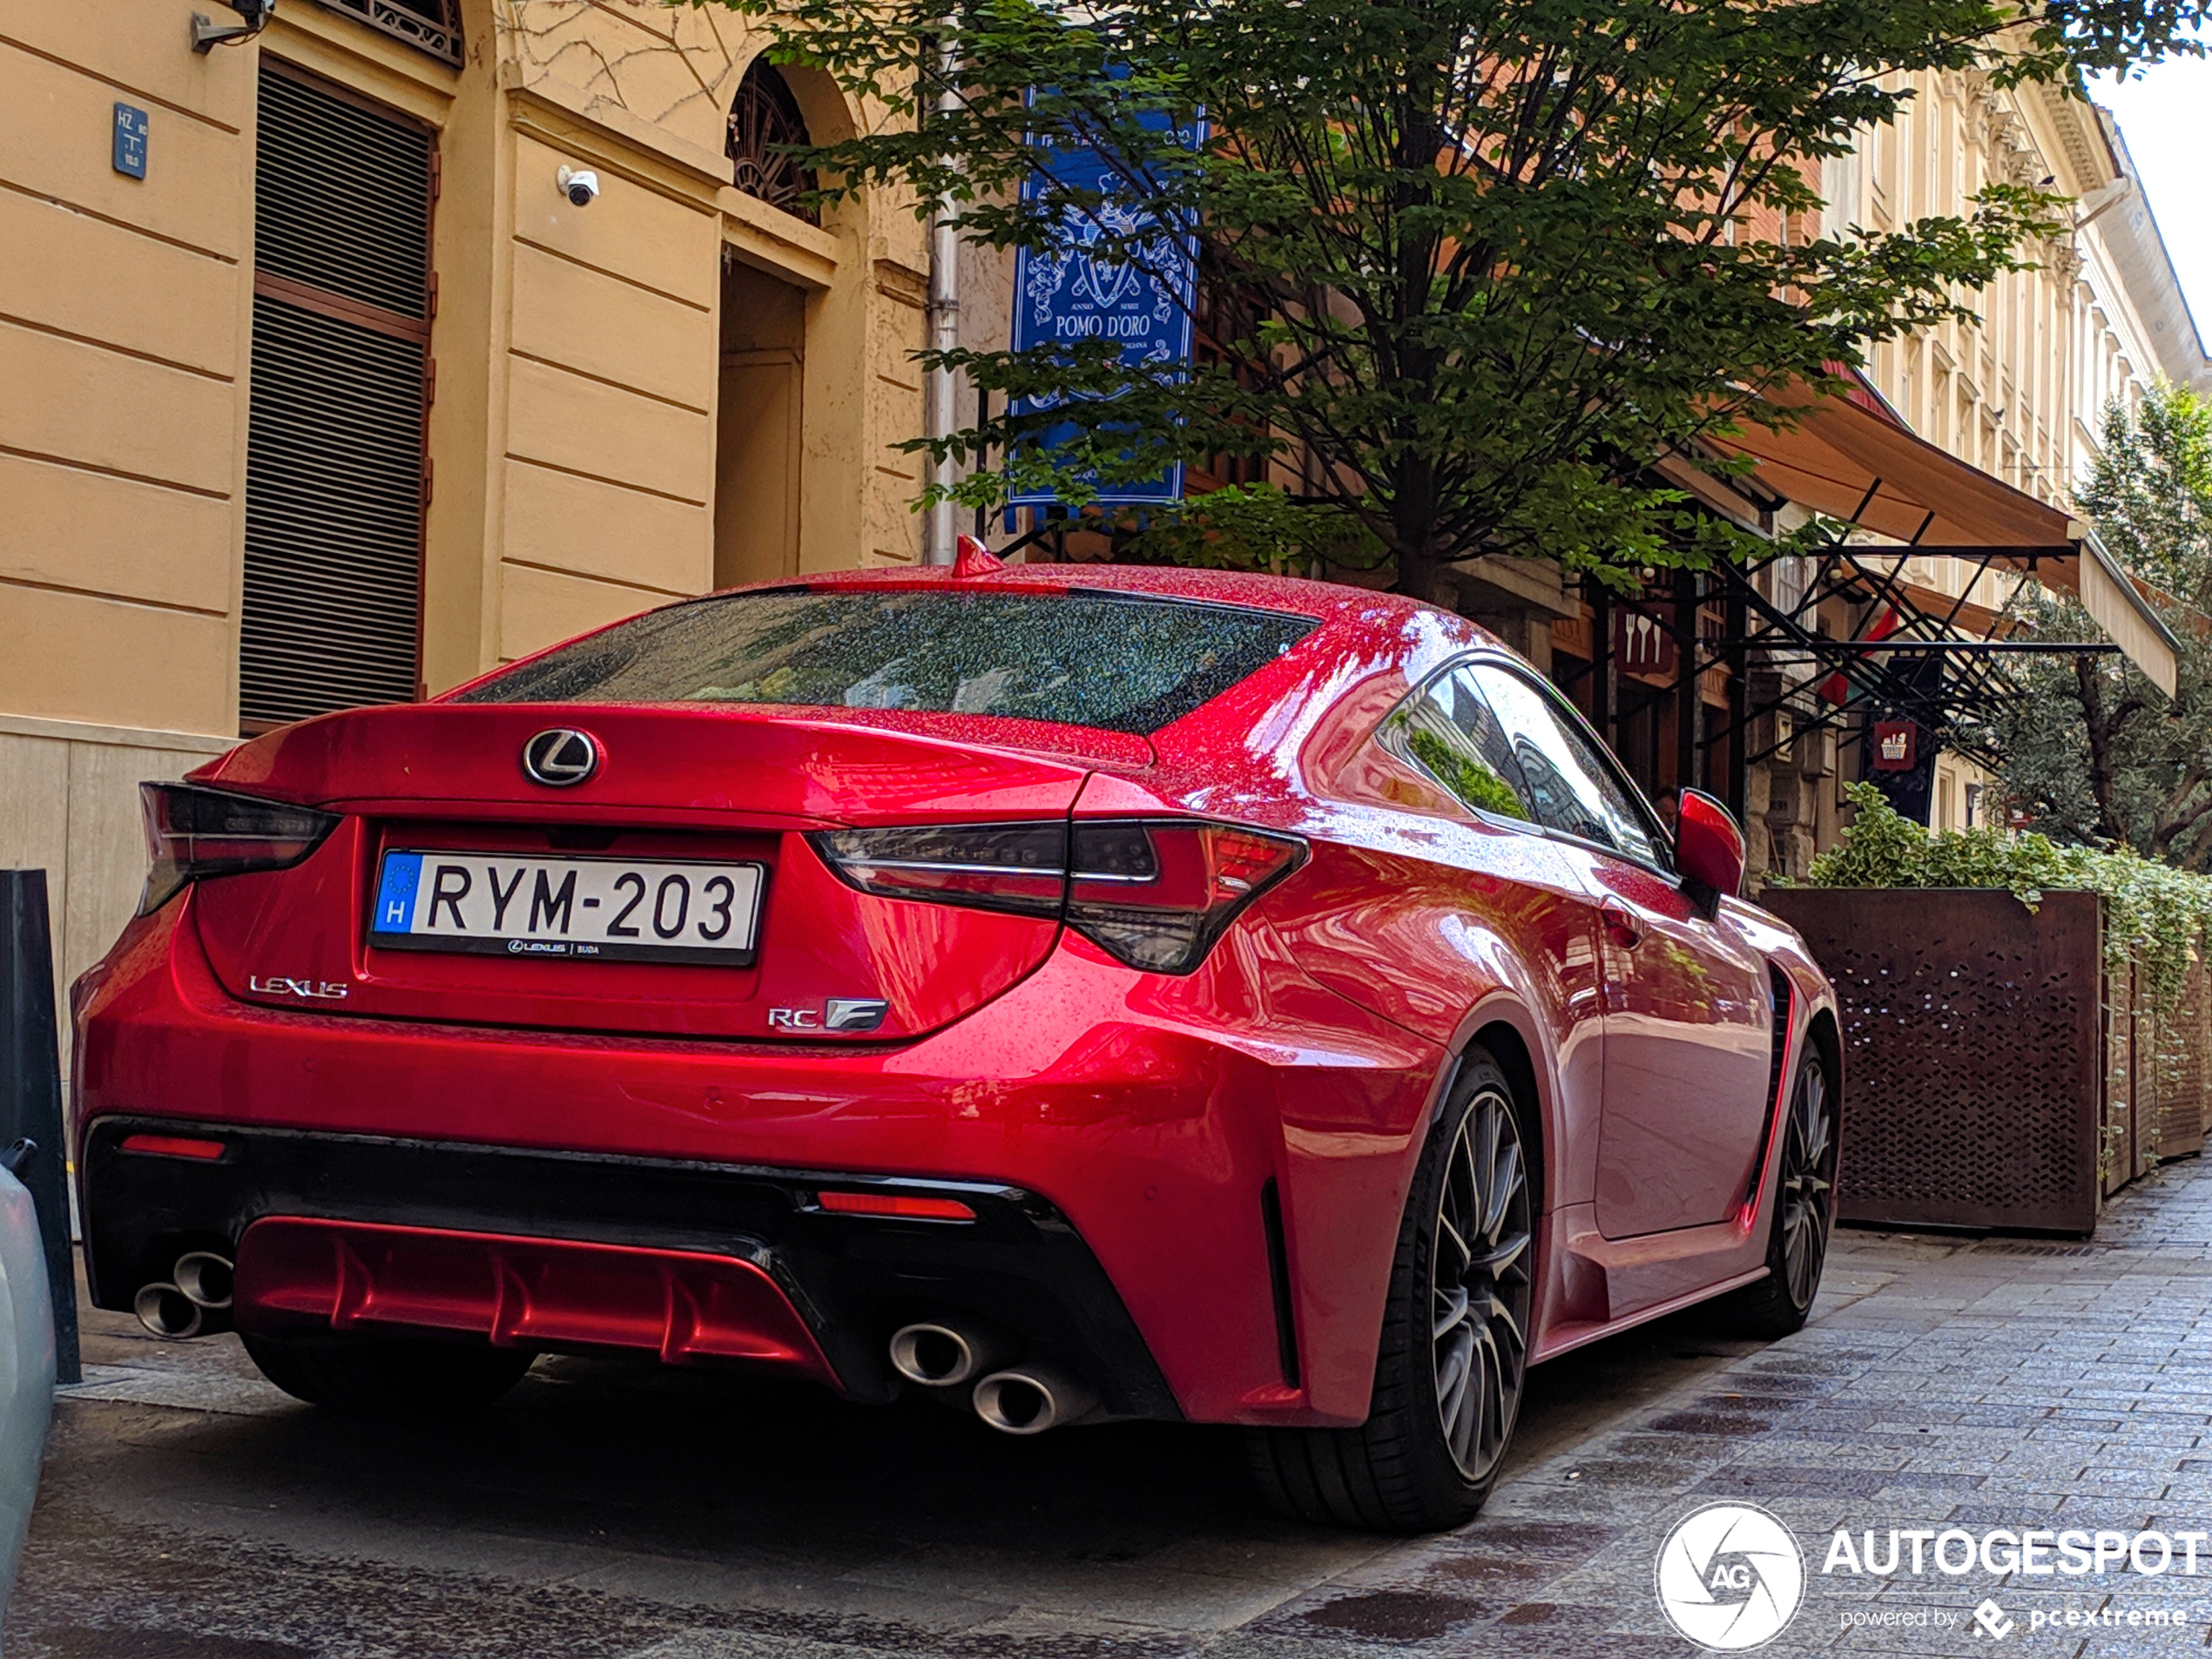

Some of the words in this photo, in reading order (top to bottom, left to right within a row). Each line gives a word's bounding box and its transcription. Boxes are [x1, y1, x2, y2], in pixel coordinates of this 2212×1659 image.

[118, 110, 132, 131] HZ
[1055, 314, 1103, 337] POMO
[1107, 314, 1150, 337] D'ORO
[387, 900, 405, 925] H
[427, 865, 736, 941] RYM-203
[524, 943, 566, 952] LEXUS
[577, 944, 599, 954] BUDA
[250, 975, 347, 999] LEXUS
[768, 1008, 818, 1028] RC
